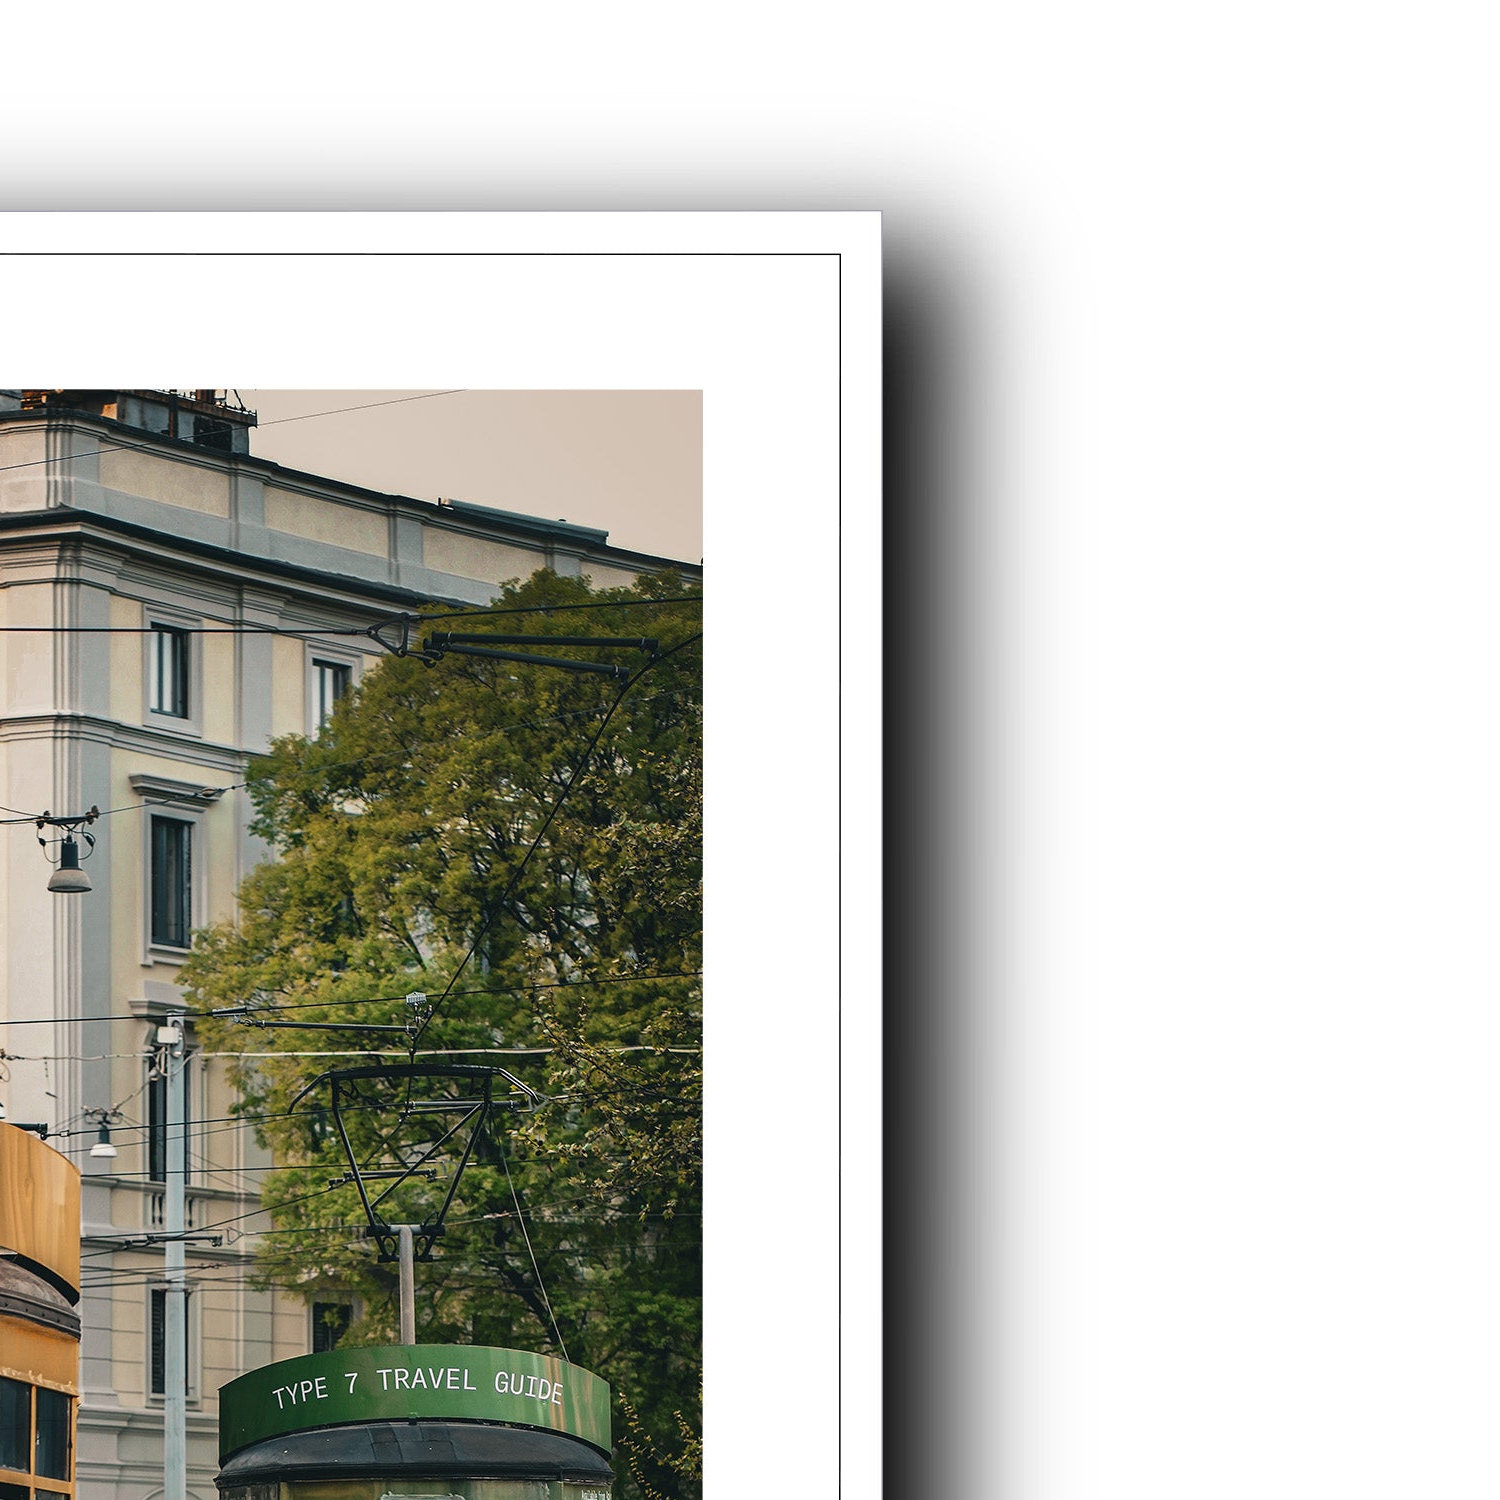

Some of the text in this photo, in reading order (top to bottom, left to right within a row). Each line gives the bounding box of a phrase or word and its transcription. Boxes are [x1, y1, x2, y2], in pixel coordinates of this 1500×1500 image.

[272, 1367, 564, 1410] TYPE 7 TRAVEL GUIDE
